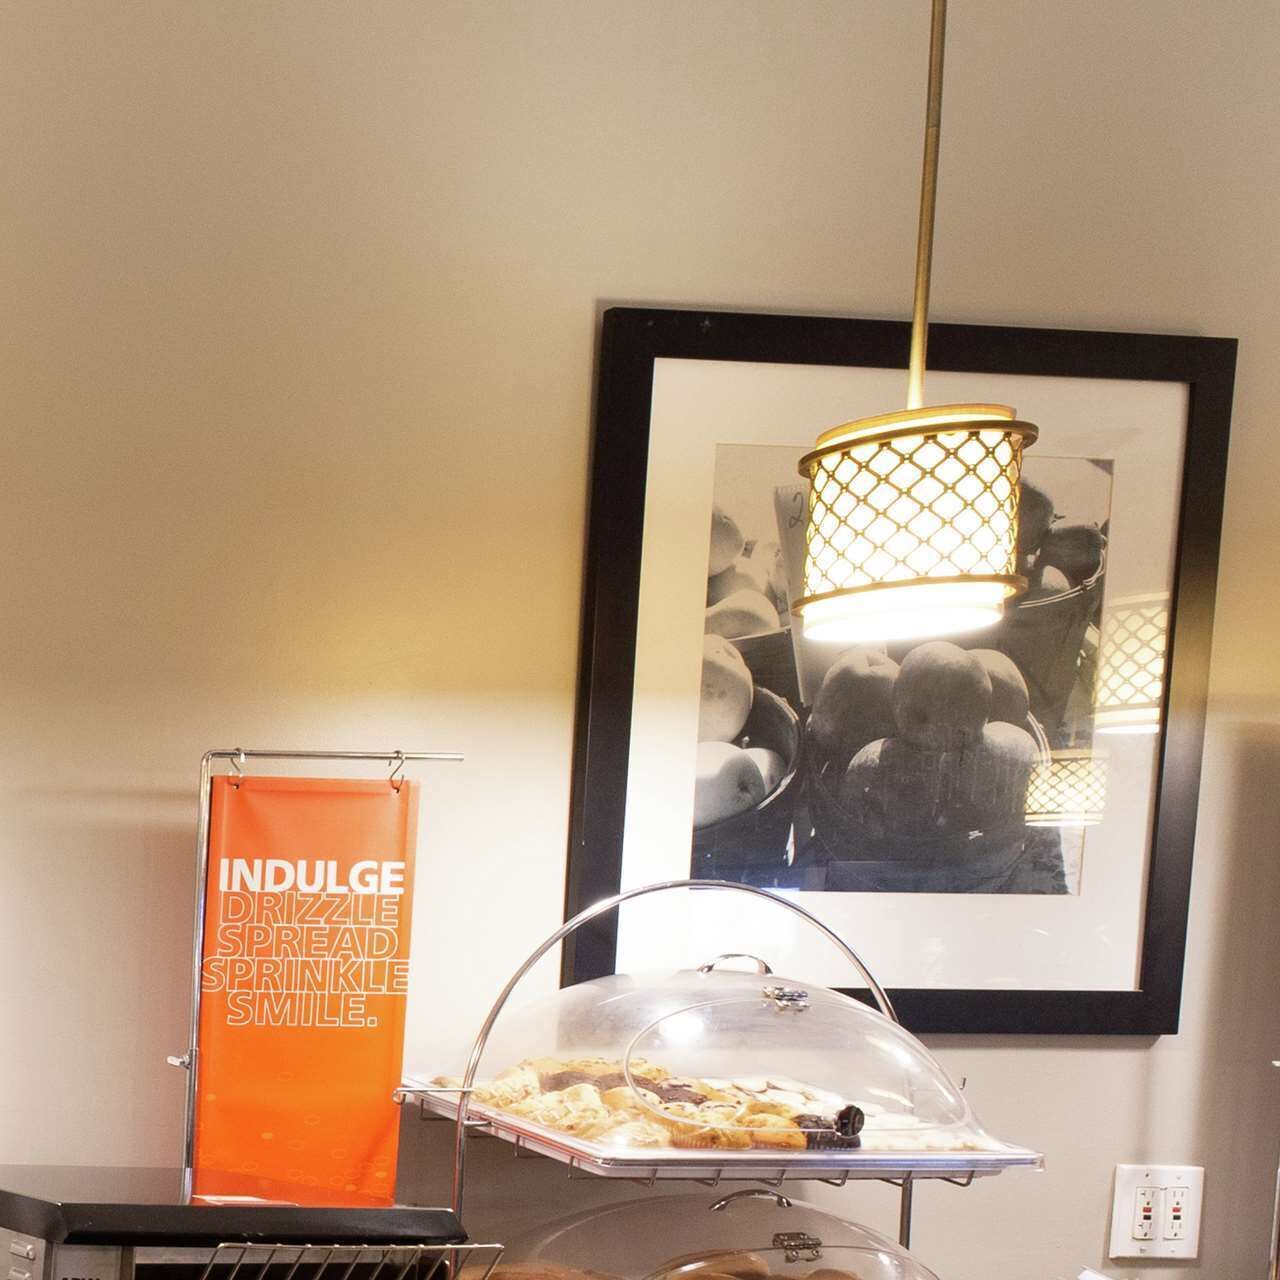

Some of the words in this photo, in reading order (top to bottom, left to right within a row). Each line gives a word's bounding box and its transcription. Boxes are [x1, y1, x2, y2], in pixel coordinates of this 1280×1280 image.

[789, 491, 805, 528] 2
[219, 858, 405, 894] INDULGE
[220, 891, 400, 927] DRIZZLE
[216, 924, 398, 960] SPREAD
[201, 956, 410, 994] SPRINKLE
[227, 990, 378, 1027] SMILE.
